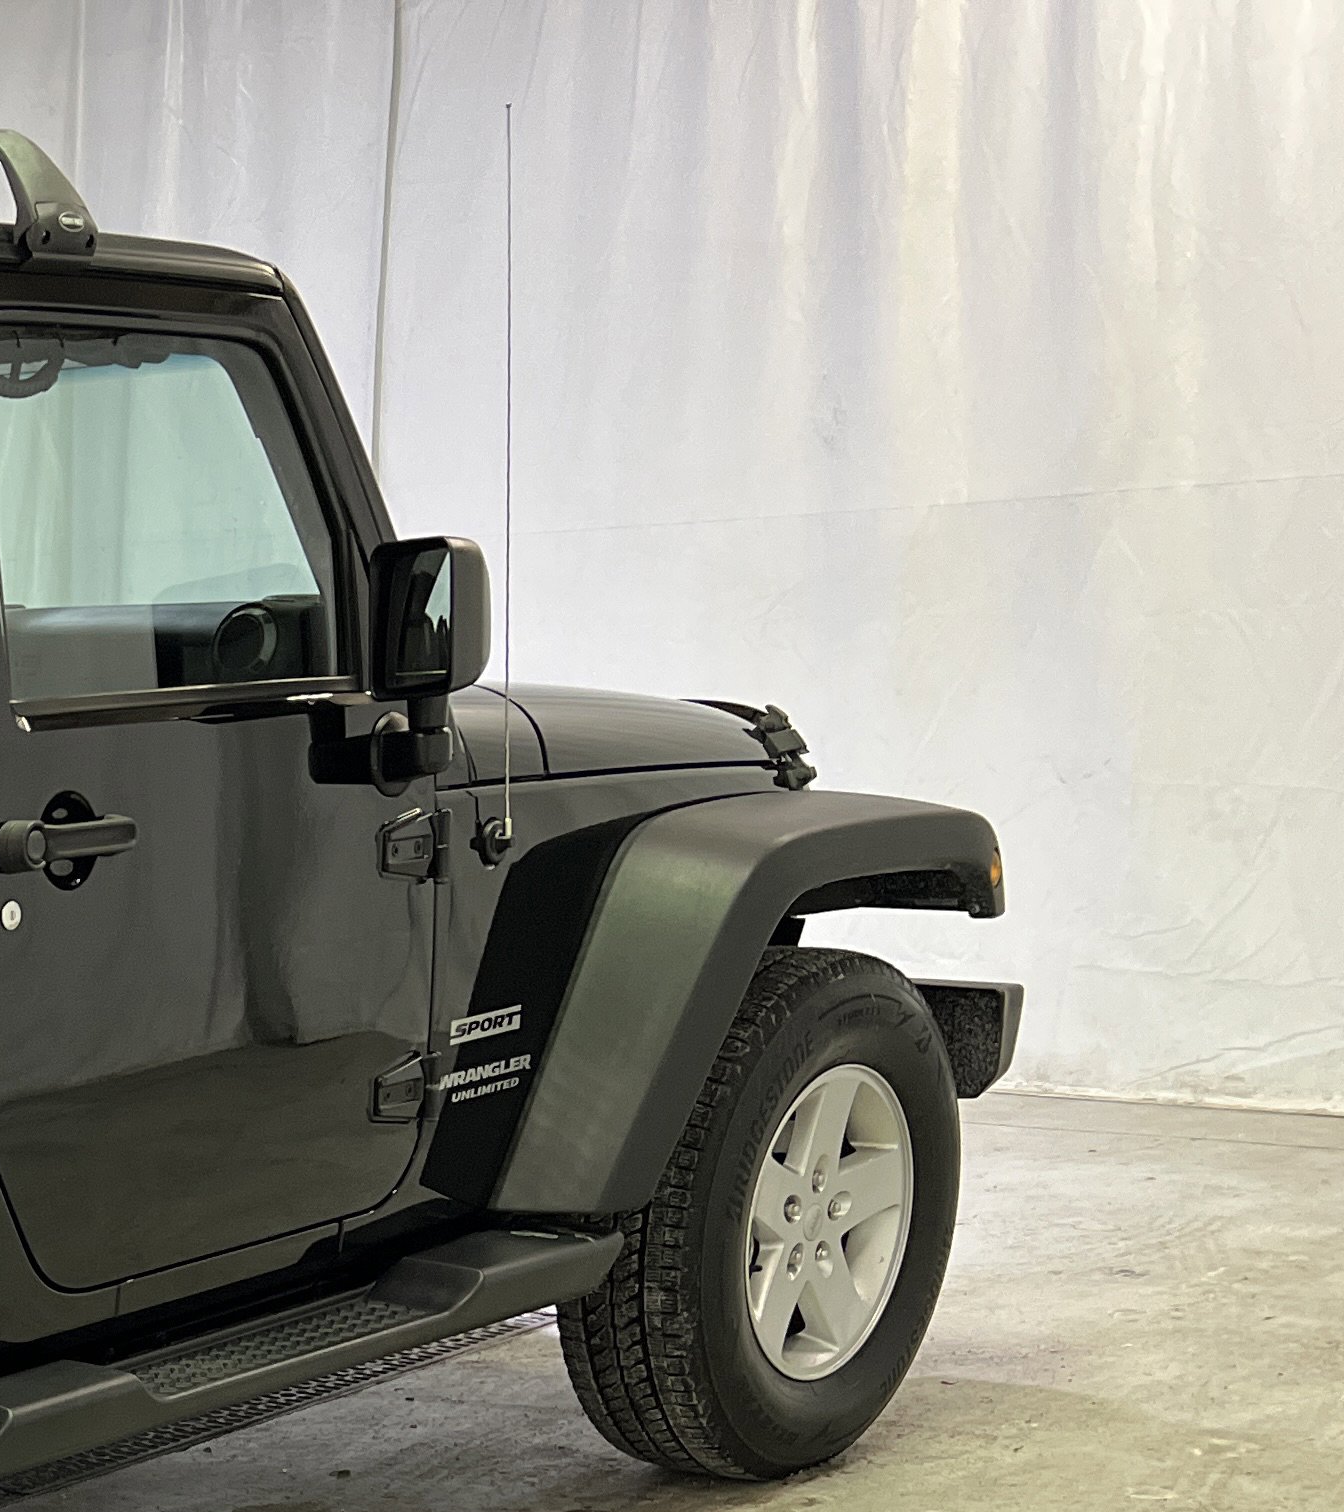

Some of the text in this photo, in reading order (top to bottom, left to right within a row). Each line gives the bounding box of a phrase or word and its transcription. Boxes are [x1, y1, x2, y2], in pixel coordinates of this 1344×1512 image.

[450, 1009, 521, 1040] SPORT
[439, 1053, 531, 1091] WRANGLER
[451, 1077, 520, 1103] UNLIMITED
